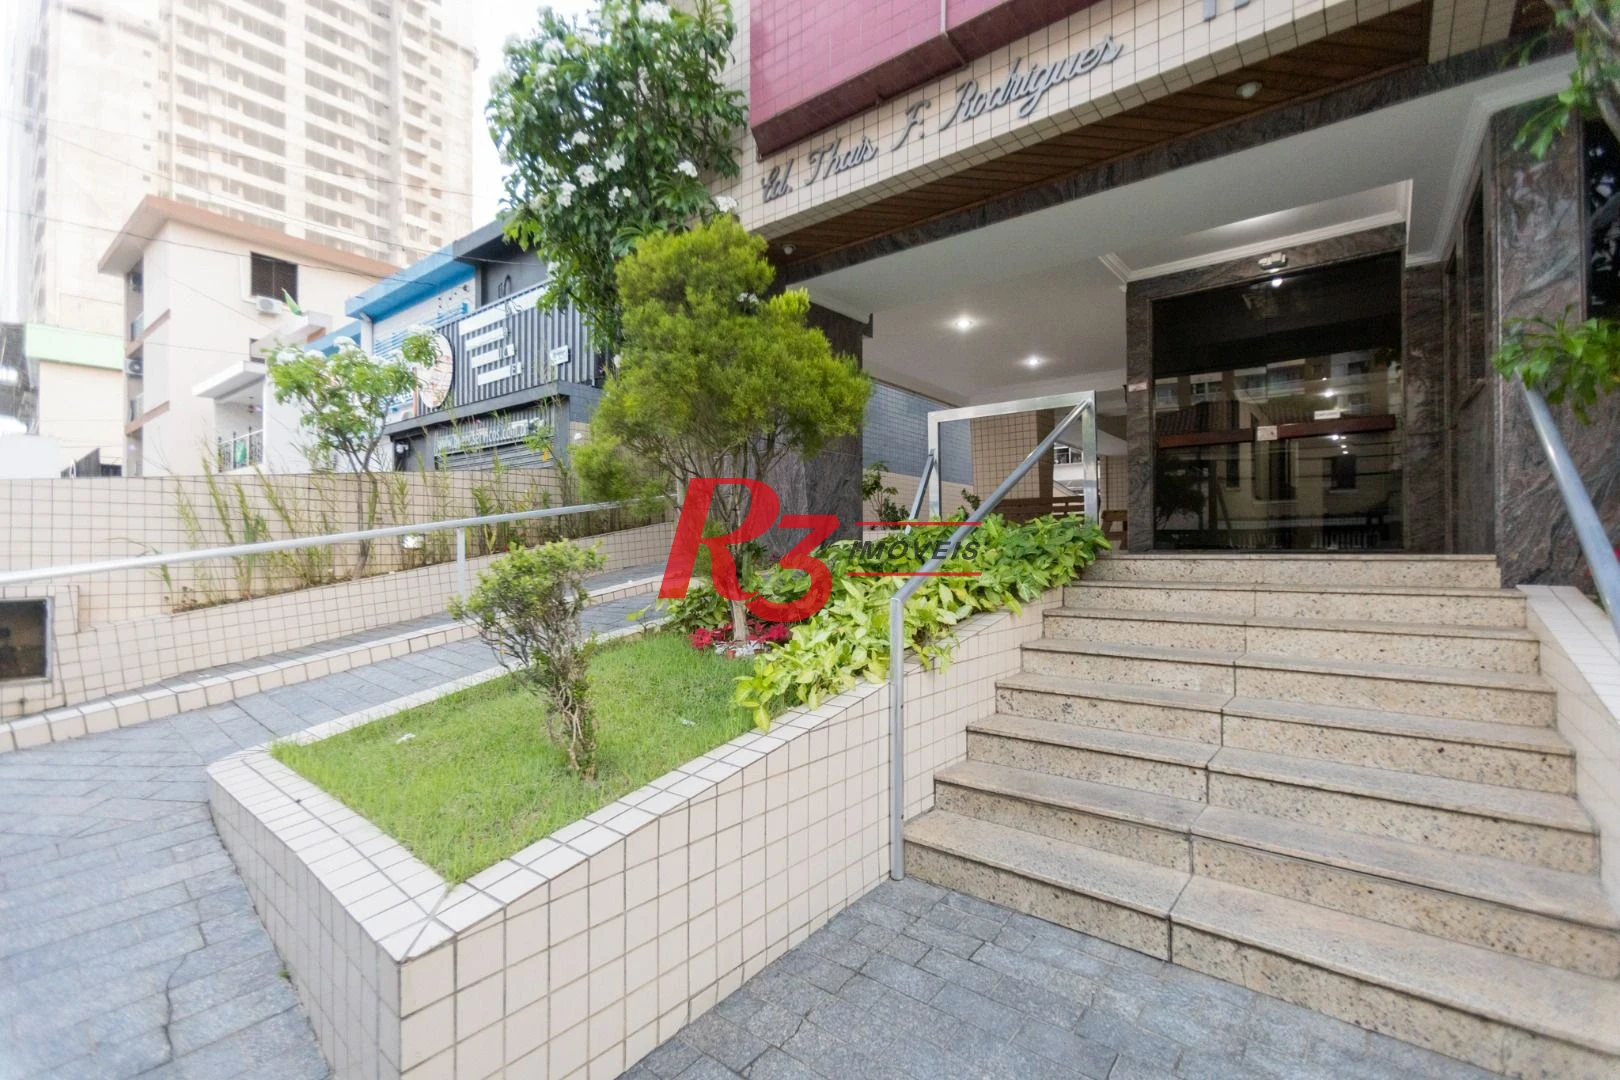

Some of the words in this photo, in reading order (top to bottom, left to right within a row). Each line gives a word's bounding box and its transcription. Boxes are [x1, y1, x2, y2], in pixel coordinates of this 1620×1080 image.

[761, 158, 793, 203] Ed.
[891, 100, 931, 152] F.
[939, 34, 1124, 131] Rodrigues
